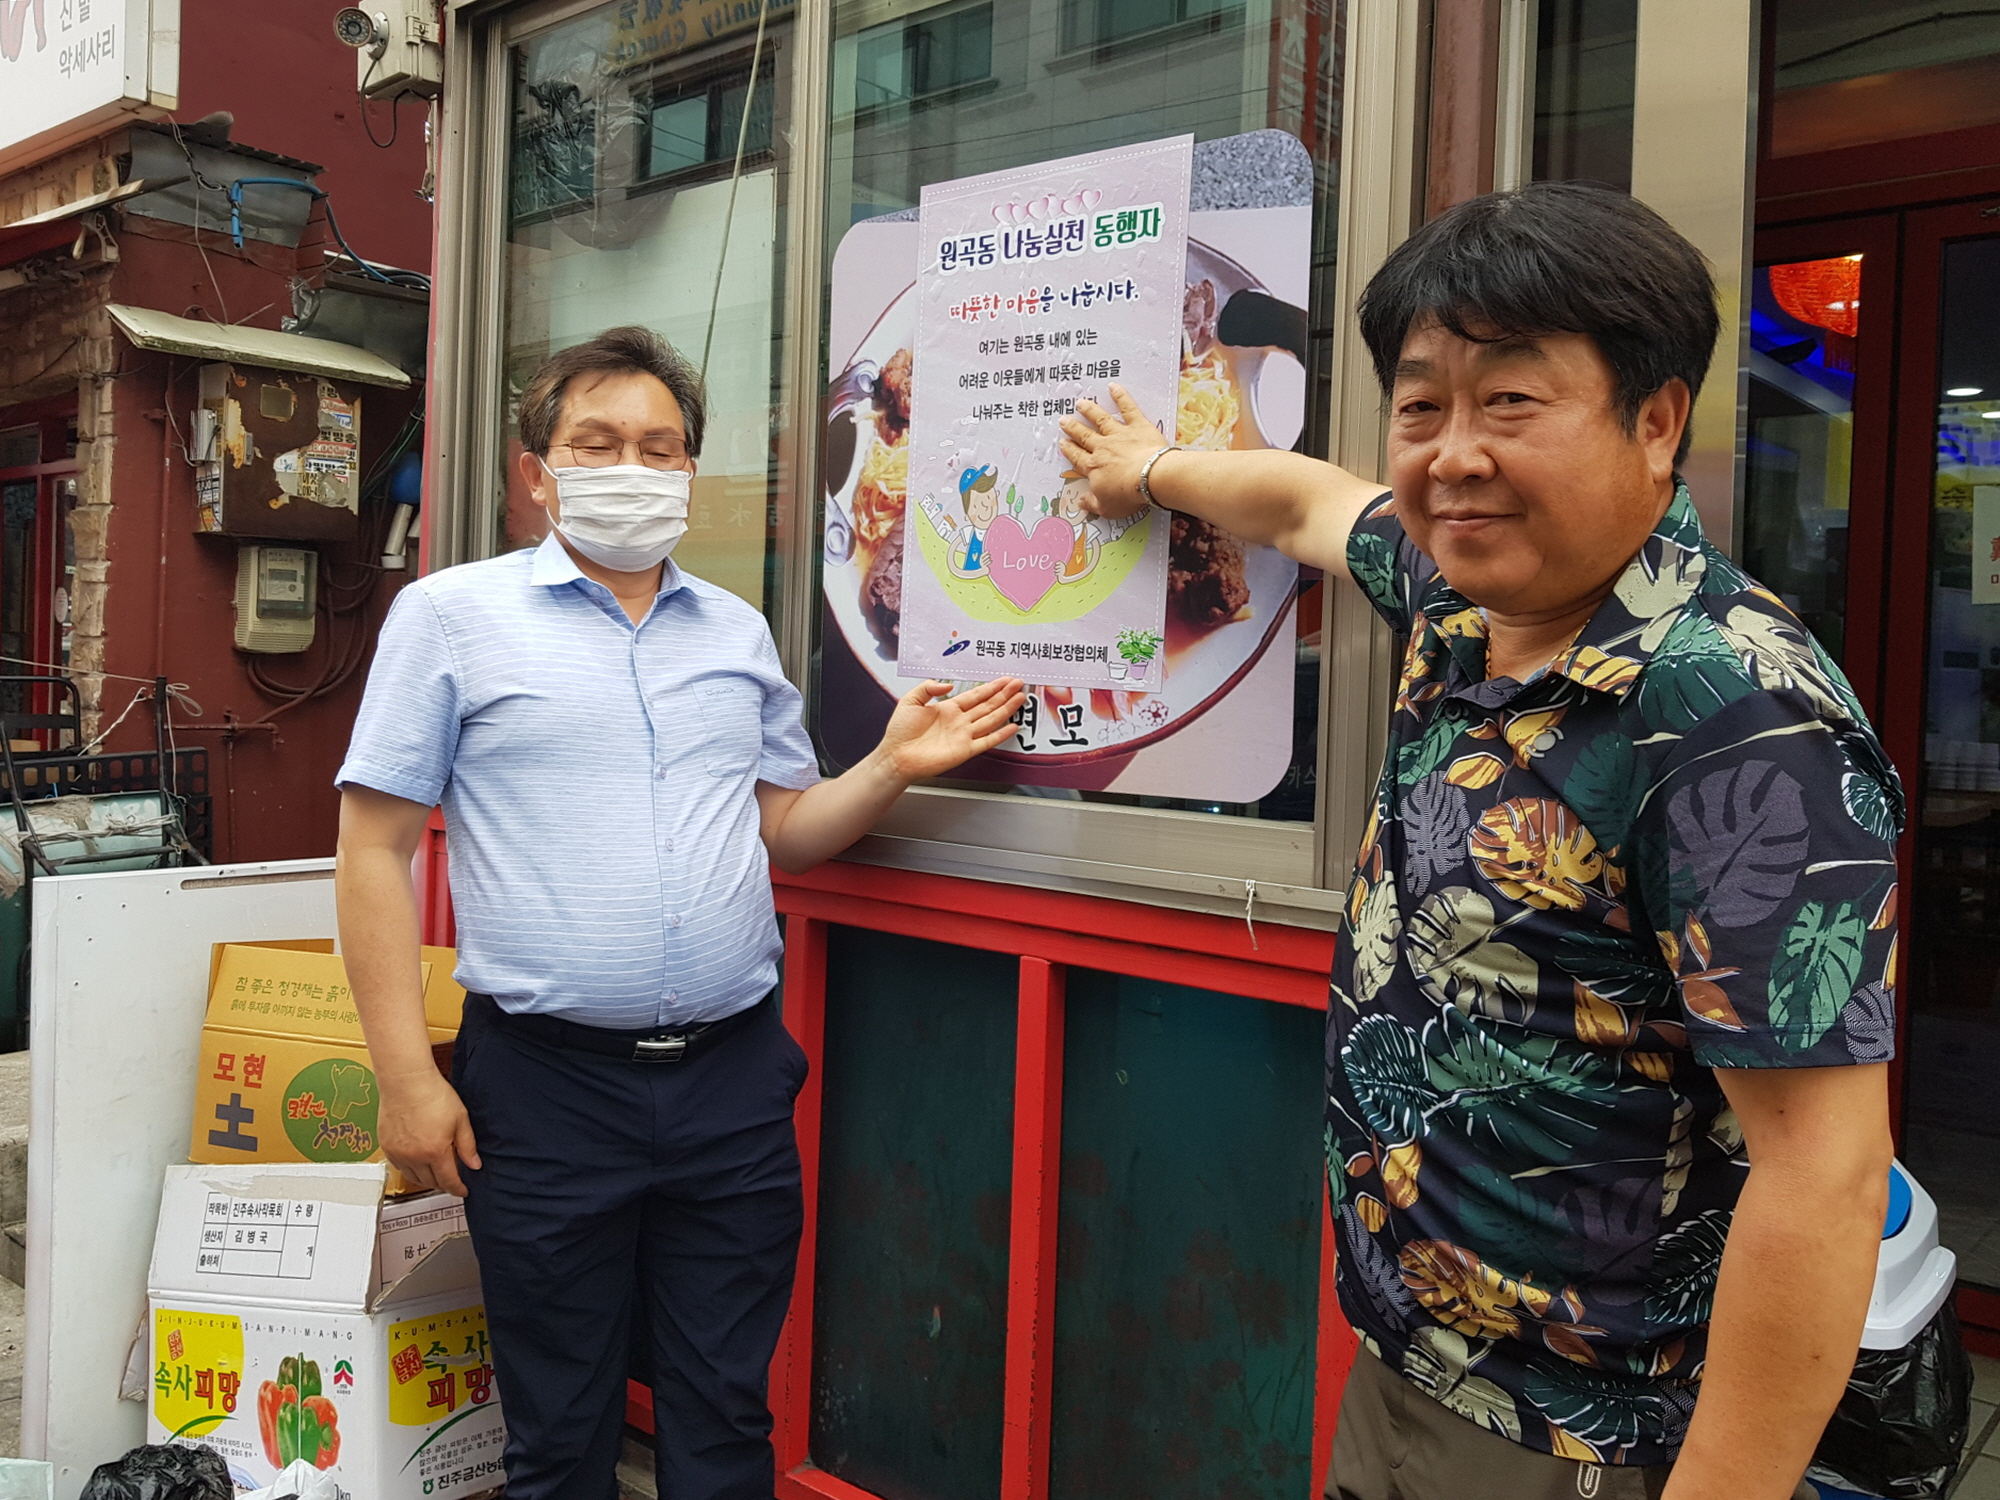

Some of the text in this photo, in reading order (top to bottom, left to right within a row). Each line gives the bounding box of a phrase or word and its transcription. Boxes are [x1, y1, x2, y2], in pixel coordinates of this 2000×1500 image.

[59, 24, 115, 79] 악세사리
[940, 207, 1161, 270] 원곡동 나눔실천 동행자
[951, 279, 1138, 322] 따뜻한 마음을 나눕시다.
[979, 328, 1098, 355] 여기는 원곡동 내에 있는
[959, 359, 1121, 390] 어려운 이웃들에게 따뜻한 마음을
[973, 403, 1013, 421] 나눠주는
[1018, 400, 1038, 417] 착한
[1003, 551, 1053, 570] Love
[976, 640, 1108, 662] 원곡동 지역사회보장협의체
[235, 977, 248, 991] 참
[250, 979, 273, 994] 좋은
[278, 981, 323, 999] 청경채는
[230, 999, 247, 1011] 흙에
[248, 1000, 271, 1014] 투자를
[272, 1003, 296, 1016] 아끼지
[296, 1006, 313, 1019] 않는
[314, 1008, 338, 1021] 농부의
[233, 1202, 284, 1218] 진주속사작목회
[204, 1230, 223, 1243] 생산자
